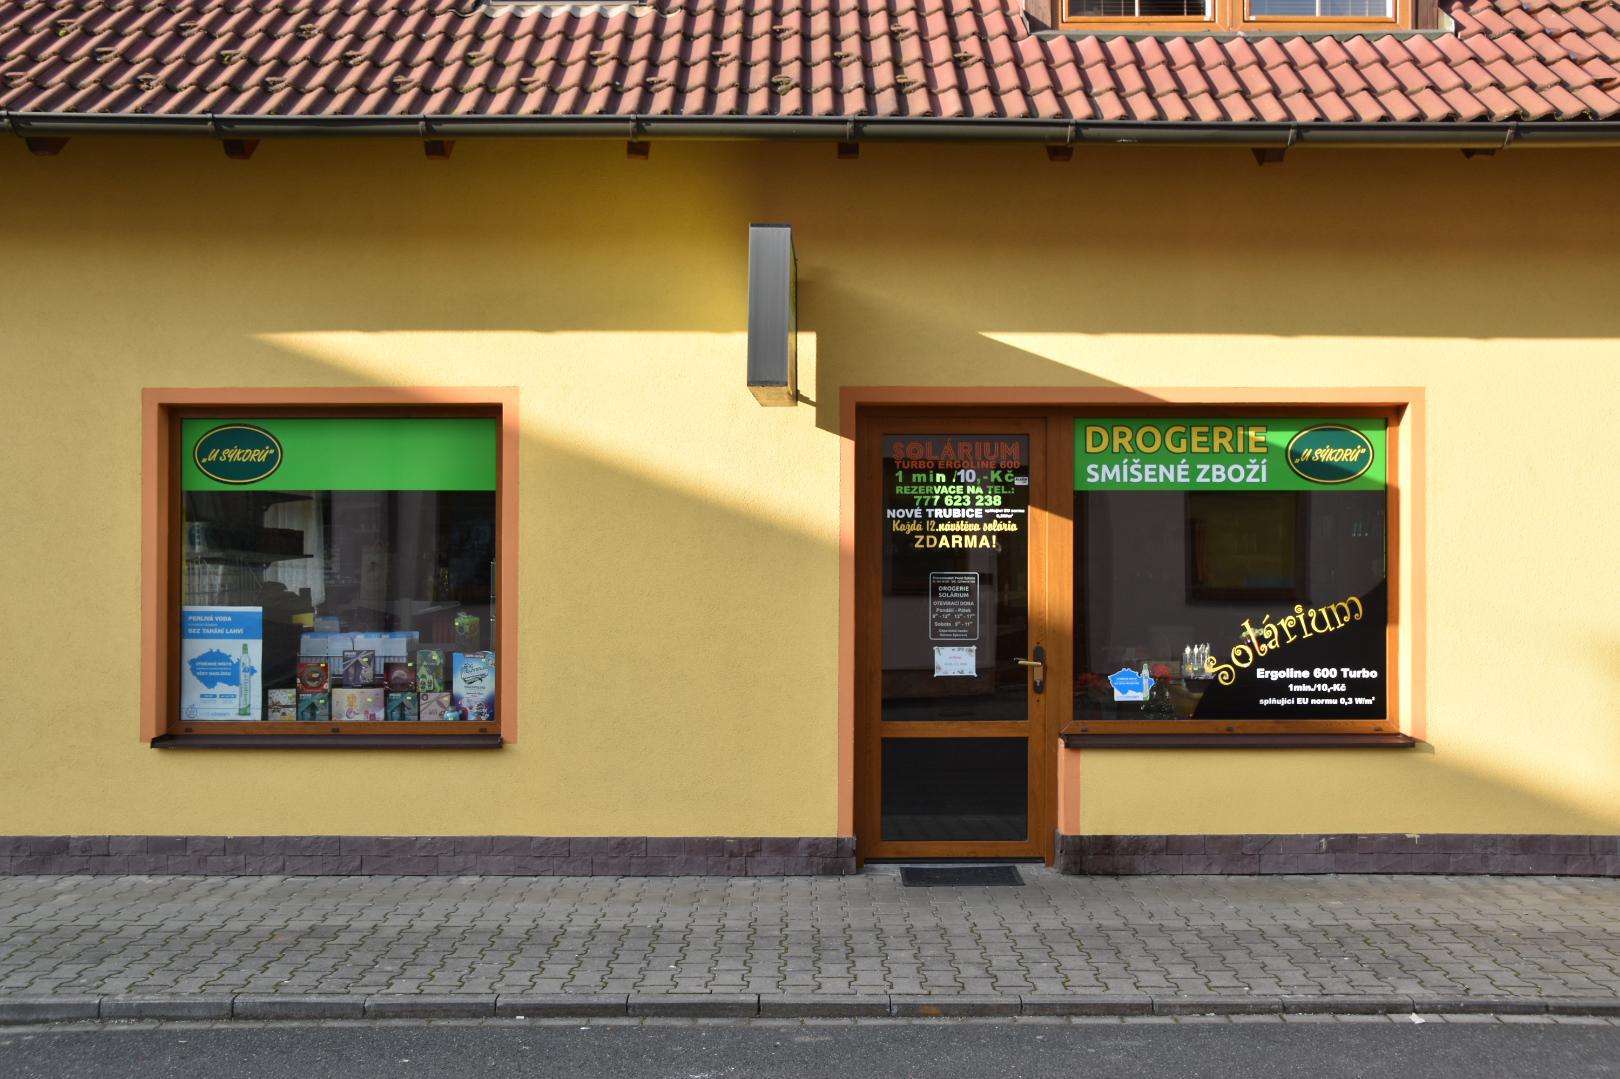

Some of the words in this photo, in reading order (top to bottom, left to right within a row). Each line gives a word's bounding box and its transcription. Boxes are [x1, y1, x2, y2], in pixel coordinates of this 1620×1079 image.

[1085, 425, 1268, 454] DROGERIE
[892, 438, 1020, 460] SOLÁRIUM
[894, 461, 935, 469] TURBO
[938, 461, 996, 469] ERGOLINE
[999, 461, 1020, 469] 600
[1086, 458, 1190, 483] SMÍŠENÉ
[1196, 458, 1268, 483] ZBOŽÍ
[895, 470, 903, 482] 1
[912, 470, 946, 482] min
[896, 485, 964, 494] REZERVACE
[966, 485, 983, 494] NA
[986, 485, 1015, 494] TEL.:
[914, 495, 940, 506] 777
[944, 495, 972, 506] 623
[975, 495, 1002, 506] 238
[886, 507, 922, 518] NOVÉ
[926, 508, 983, 518] TRUBICE
[892, 520, 923, 534] Každá
[982, 519, 1018, 532] solária
[914, 535, 997, 548] ZDARMA!
[1203, 596, 1364, 686] Solárium
[1256, 668, 1310, 681] Ergoline
[1313, 668, 1338, 679] 600
[1341, 668, 1378, 679] Turbo
[1259, 697, 1295, 707] splňující
[1340, 698, 1353, 706] 0,3
